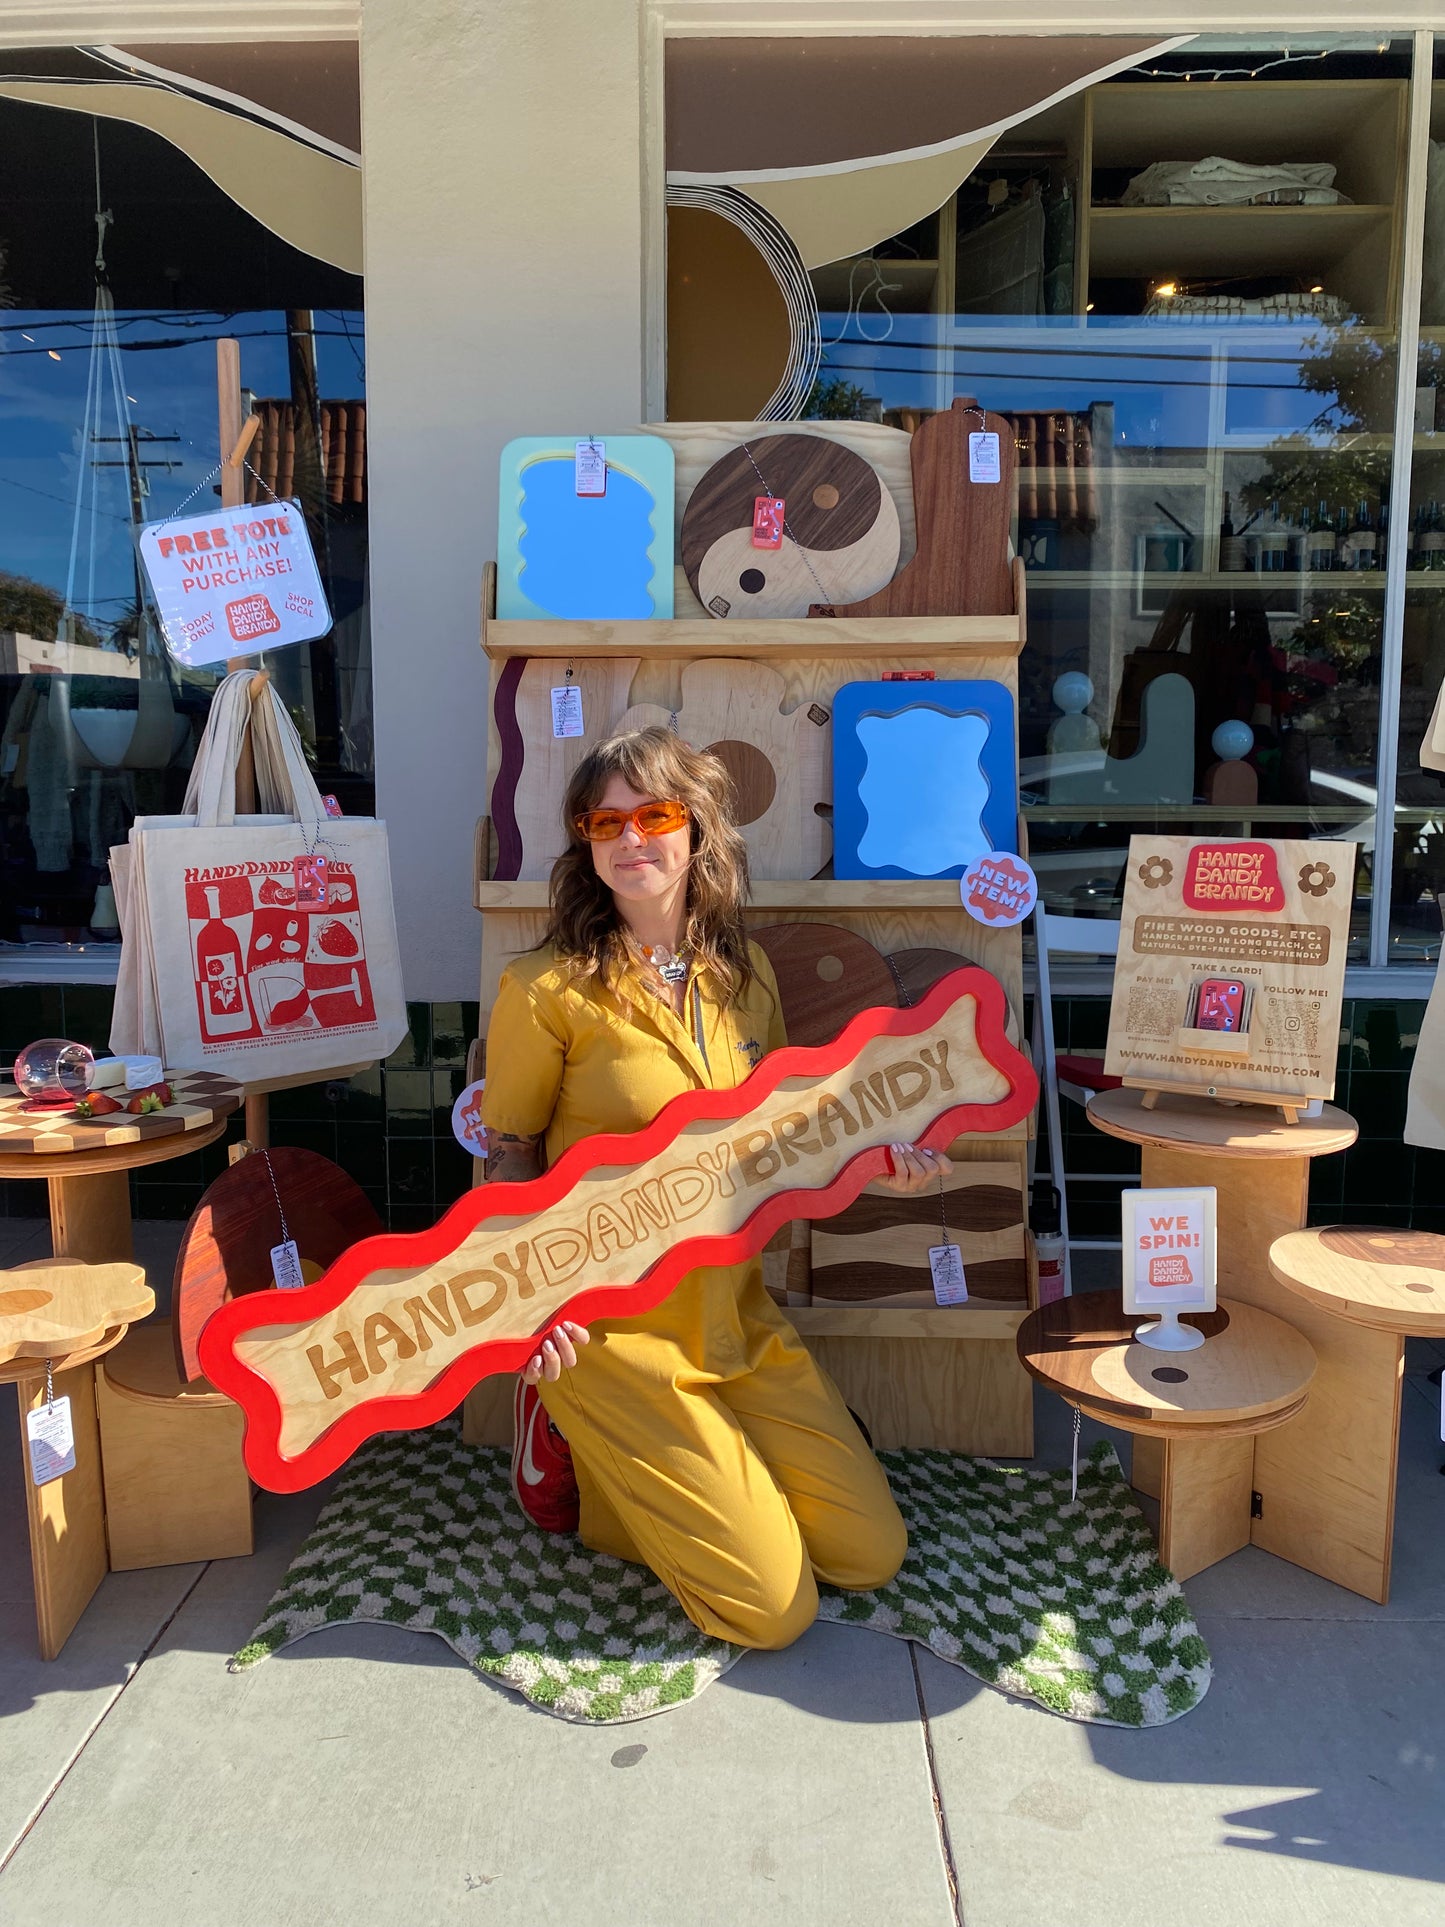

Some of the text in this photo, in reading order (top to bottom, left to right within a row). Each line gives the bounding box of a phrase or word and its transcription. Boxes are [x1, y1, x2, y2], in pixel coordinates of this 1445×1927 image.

[158, 516, 292, 558] FREE TOTE
[182, 541, 280, 573] WITH ANY
[181, 558, 292, 594] PURCHASE!
[229, 599, 267, 617] HANDY
[287, 592, 314, 606] SHOP
[231, 609, 268, 627] DANDY
[285, 602, 314, 618] LOCAL
[181, 611, 213, 634] TODAY
[234, 618, 278, 637] BRANDY
[190, 622, 216, 642] ONLY
[1198, 852, 1264, 869] HANDY
[979, 865, 1029, 895] NEW
[1195, 867, 1262, 885] DANDY
[969, 878, 1025, 912] ITEM!
[1194, 883, 1275, 903] BRANDY
[1143, 921, 1321, 940] FINE WOOD GOODS, ETC.
[1141, 942, 1185, 951] NATURAL,
[1189, 945, 1236, 953] DYE-FREE
[1249, 949, 1321, 959] ECO-FRIENDLY
[1142, 933, 1215, 943] HANDCRAFTED
[1266, 941, 1304, 950] BEACH,
[1191, 963, 1217, 972] TAKE
[1230, 966, 1262, 975] CARD!
[1136, 975, 1175, 985] PAY ME!
[1264, 985, 1328, 997] FOLLOW ME!
[1120, 1050, 1320, 1078] WWW.HANDYDANDYBRANDY.COM
[1149, 1216, 1189, 1231] WE
[1139, 1233, 1200, 1250] SPIN!
[1153, 1260, 1184, 1268] HANDY
[1153, 1267, 1184, 1275] DANDY
[1153, 1274, 1190, 1283] BRANDY
